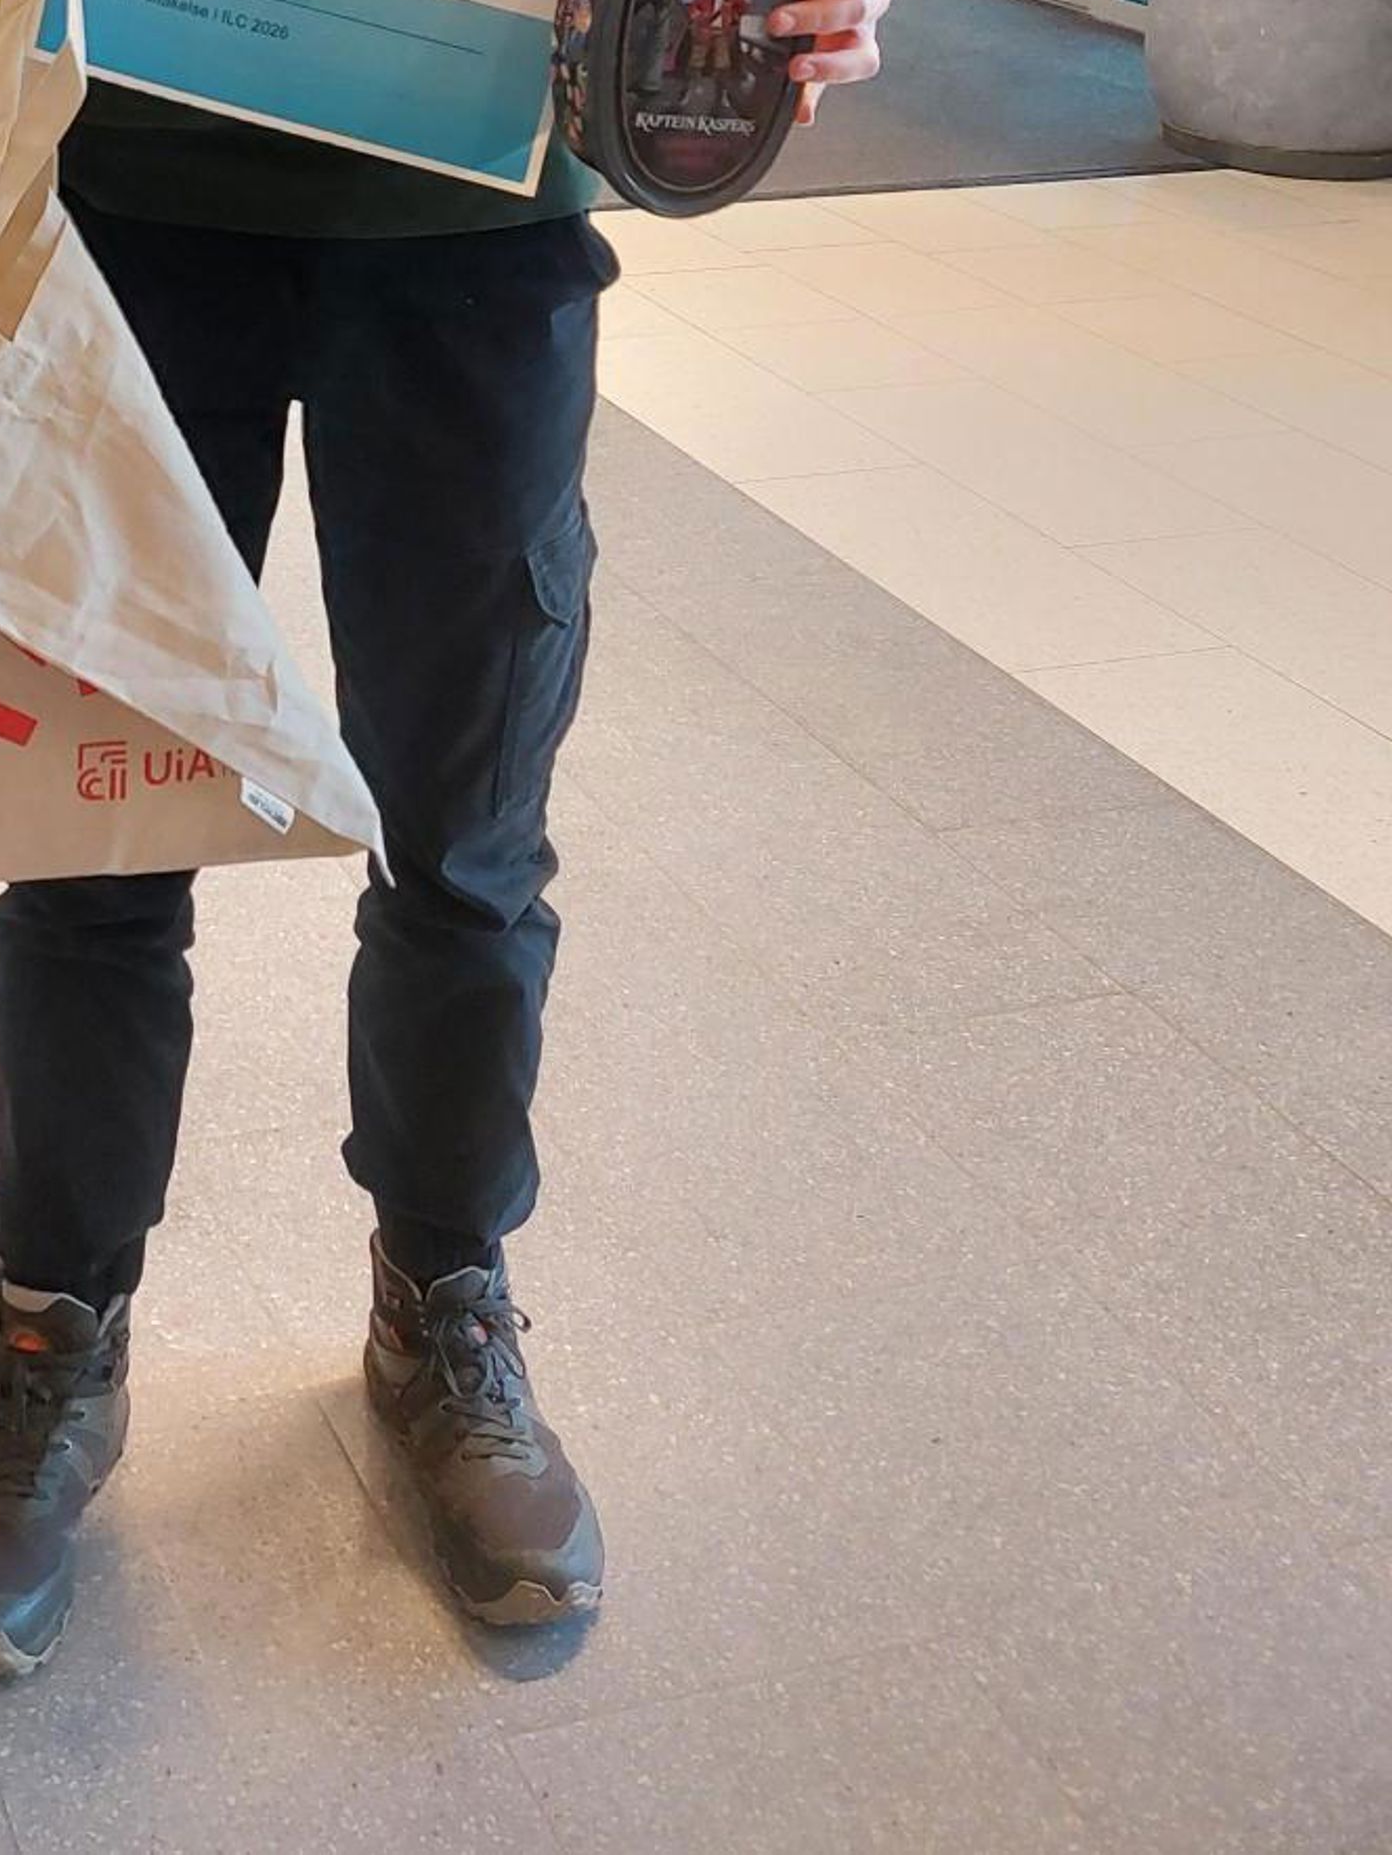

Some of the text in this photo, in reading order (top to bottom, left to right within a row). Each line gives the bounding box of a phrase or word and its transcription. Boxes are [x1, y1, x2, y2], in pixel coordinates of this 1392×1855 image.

[220, 9, 248, 30] ILC
[250, 18, 290, 41] 2026
[634, 111, 758, 137] KAPTEIN KASPERS
[144, 746, 215, 785] UiA
